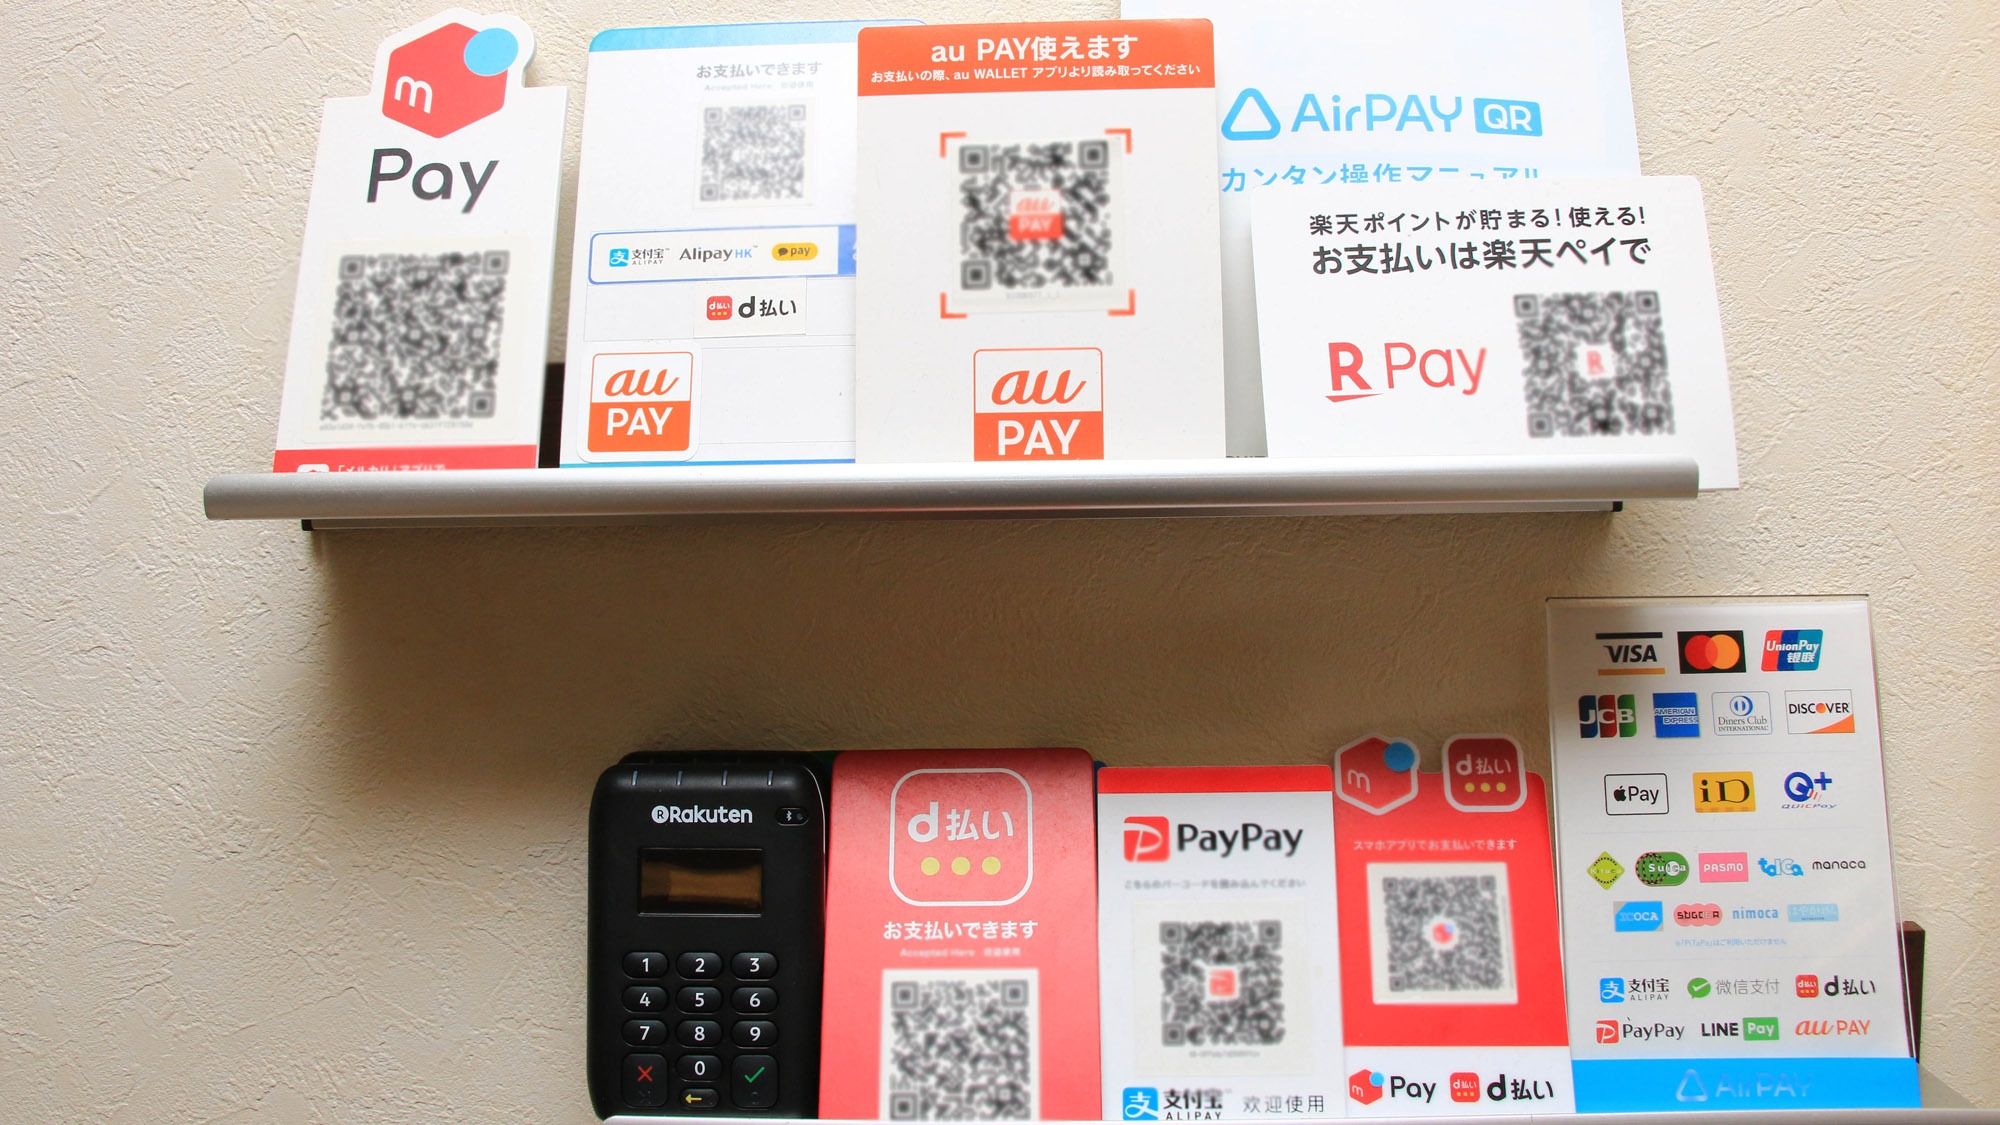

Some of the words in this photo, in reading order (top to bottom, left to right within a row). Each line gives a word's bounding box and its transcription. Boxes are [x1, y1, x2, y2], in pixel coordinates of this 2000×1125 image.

[931, 45, 965, 62] au
[977, 34, 1138, 61] PAY使えます
[696, 61, 823, 79] お支払いできます
[974, 67, 1027, 79] WALLET
[1033, 63, 1201, 79] アプリより読み取ってください
[1290, 93, 1462, 133] AirPAY
[1483, 103, 1533, 132] QR
[367, 147, 500, 214] Pay
[631, 248, 664, 259] 支付宝
[790, 246, 811, 257] pay
[1312, 237, 1652, 275] お支払いは楽天ペイで
[738, 296, 797, 319] d払い
[1328, 341, 1373, 392] R
[1384, 341, 1487, 396] Pay
[604, 369, 680, 397] au
[991, 369, 1087, 405] au
[607, 407, 674, 436] PAY
[998, 419, 1081, 456] PAY
[1603, 644, 1657, 665] VISA
[1766, 639, 1820, 655] UnionPay
[1579, 709, 1635, 725] JCB
[1654, 707, 1695, 716] AMERICAN
[1663, 716, 1699, 725] EXPRESS
[1718, 716, 1746, 726] Diners
[1748, 716, 1768, 726] Club
[1456, 753, 1512, 776] d払い
[1628, 785, 1660, 804] Pay
[1700, 779, 1750, 804] iD
[670, 805, 753, 824] Rakuten
[907, 801, 1014, 843] d払い
[1177, 823, 1304, 858] PayPay
[1353, 839, 1518, 851] スマホアプリでお支払いできます
[1649, 863, 1687, 873] Suica
[1703, 863, 1744, 873] PASMO
[1812, 860, 1866, 870] manaca
[1732, 906, 1779, 920] nimoca
[883, 920, 1039, 941] お支払いできます
[642, 958, 649, 973] 1
[695, 958, 705, 973] 2
[750, 958, 760, 973] 3
[1628, 978, 1670, 993] 支付宝
[1716, 979, 1780, 995] 微信支付
[1824, 975, 1876, 997] d払い
[639, 993, 651, 1007] 4
[695, 993, 705, 1007] 5
[750, 993, 760, 1007] 6
[640, 1026, 650, 1040] 7
[694, 1026, 705, 1041] 8
[750, 1026, 761, 1041] 9
[1622, 1022, 1685, 1040] PayPay
[1701, 1022, 1739, 1037] LINE
[1747, 1022, 1775, 1037] Pay
[1795, 1019, 1833, 1036] au
[1836, 1019, 1871, 1035] PAY
[694, 1061, 705, 1076] 0
[1390, 1075, 1437, 1104] Pay
[1487, 1074, 1555, 1102] d払い
[1715, 1073, 1812, 1098] AirPAY
[1163, 1088, 1223, 1110] 支付宝
[1243, 1094, 1325, 1113] 欢迎使用
[1166, 1111, 1222, 1121] ALIPAY
